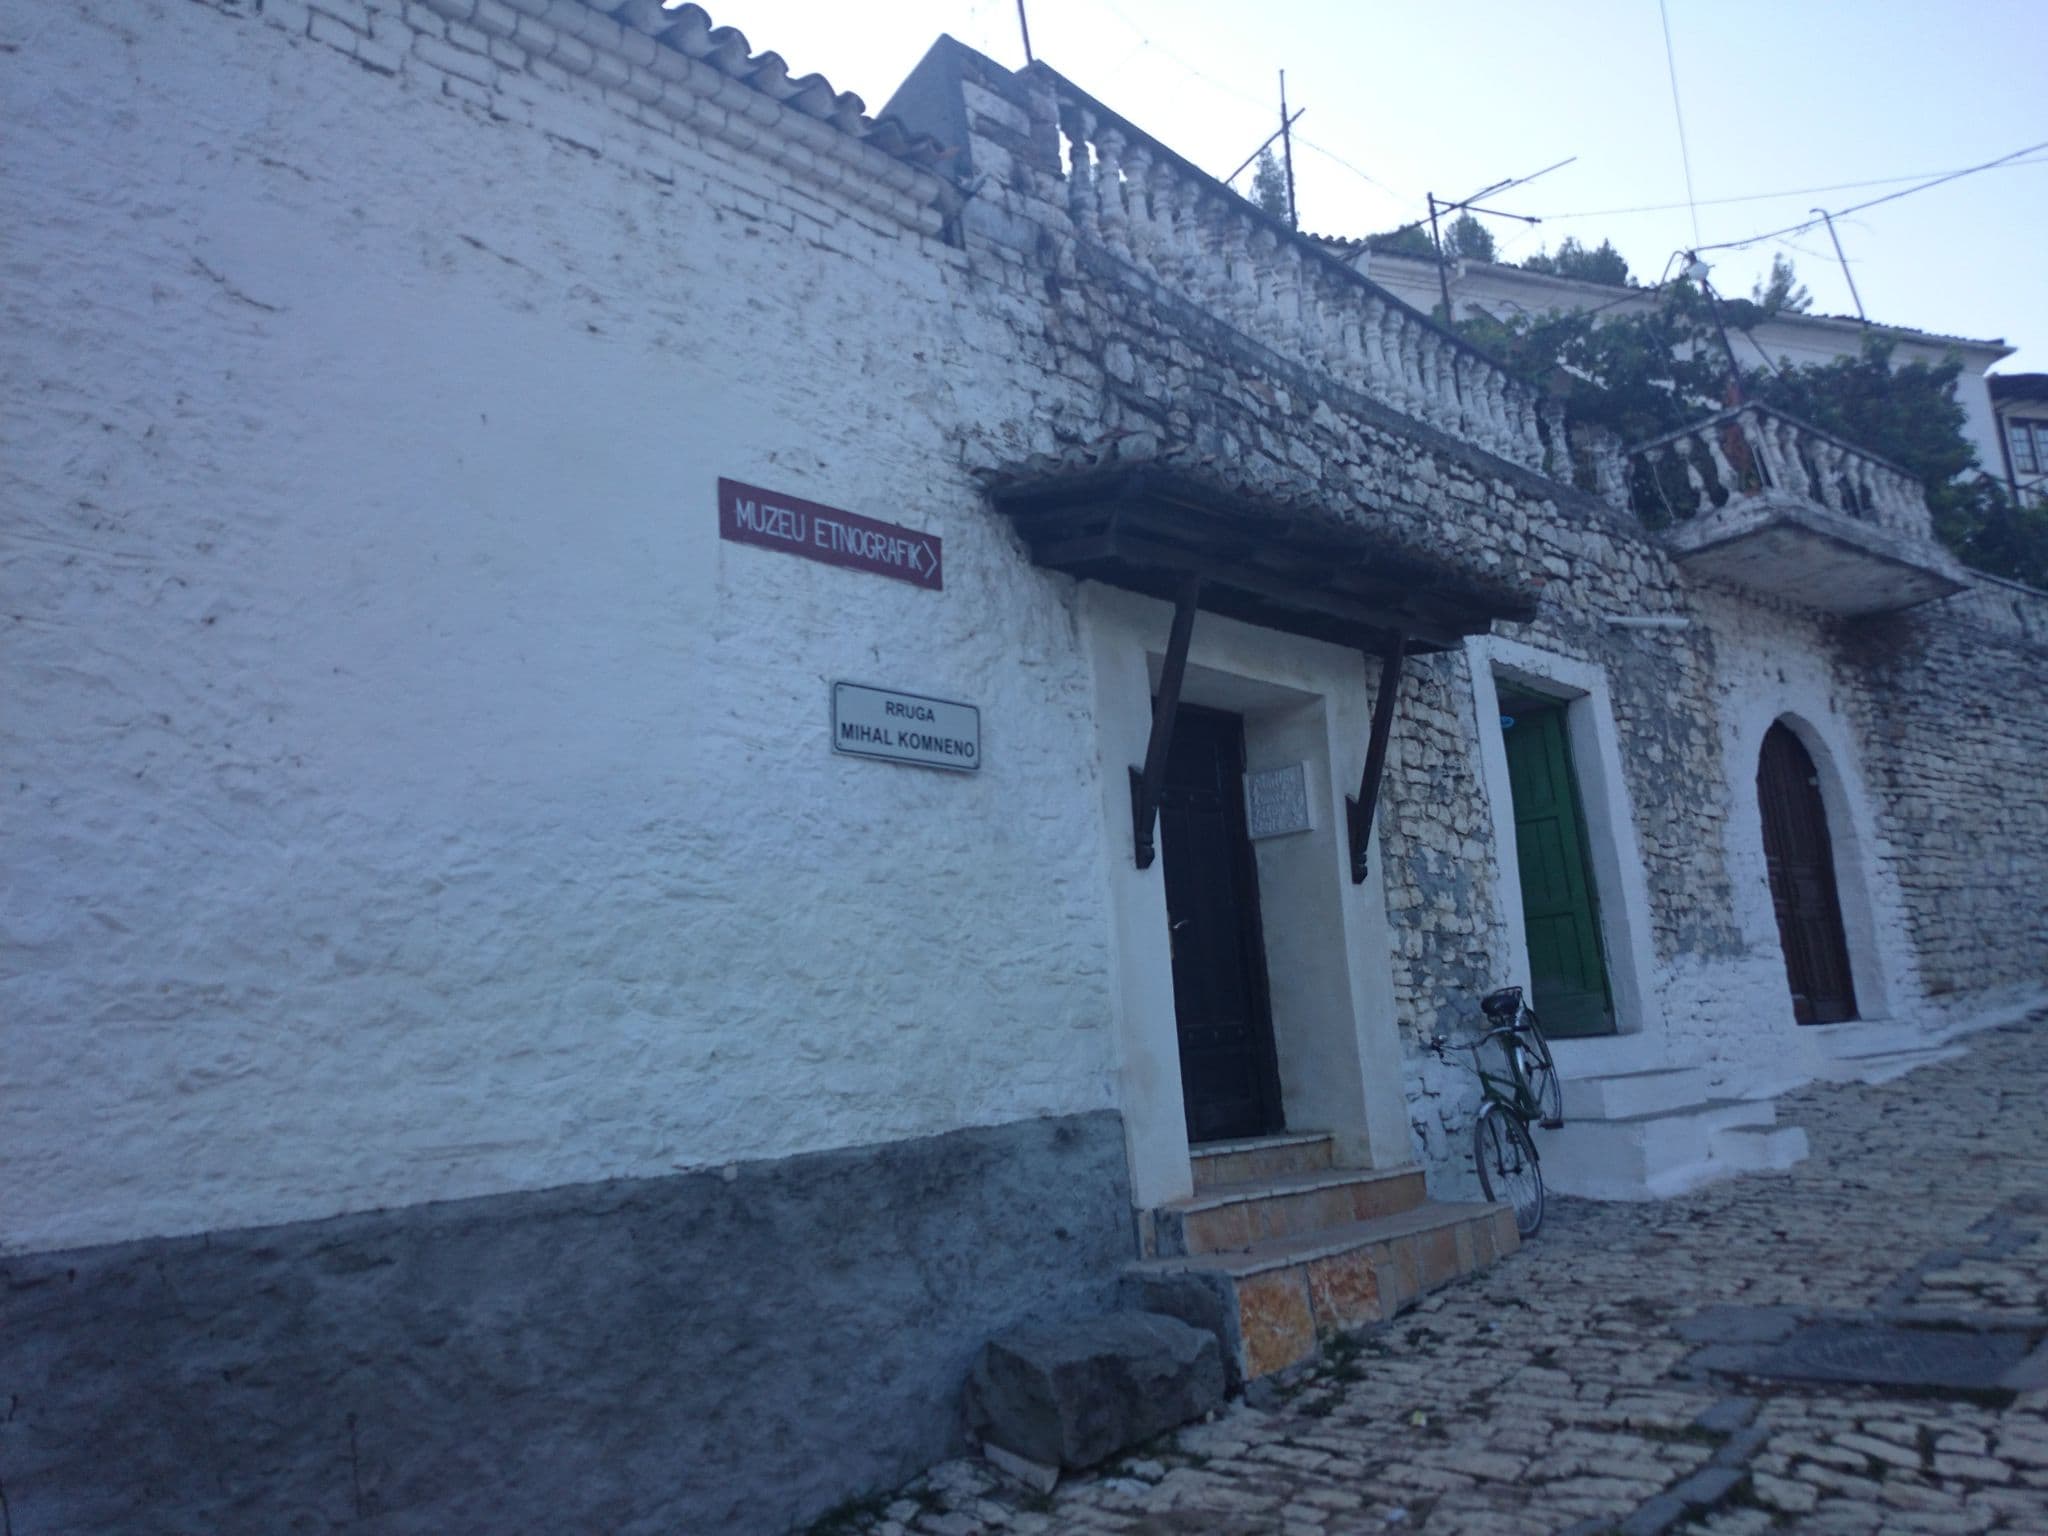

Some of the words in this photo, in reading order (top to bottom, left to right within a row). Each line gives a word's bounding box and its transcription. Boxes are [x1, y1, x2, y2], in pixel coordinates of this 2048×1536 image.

[735, 498, 806, 543] MUZEU
[814, 518, 923, 571] ETNOGRAFIK
[885, 700, 936, 723] RRUGA
[840, 722, 893, 746] MIHAL
[897, 731, 975, 758] KOMNENO
